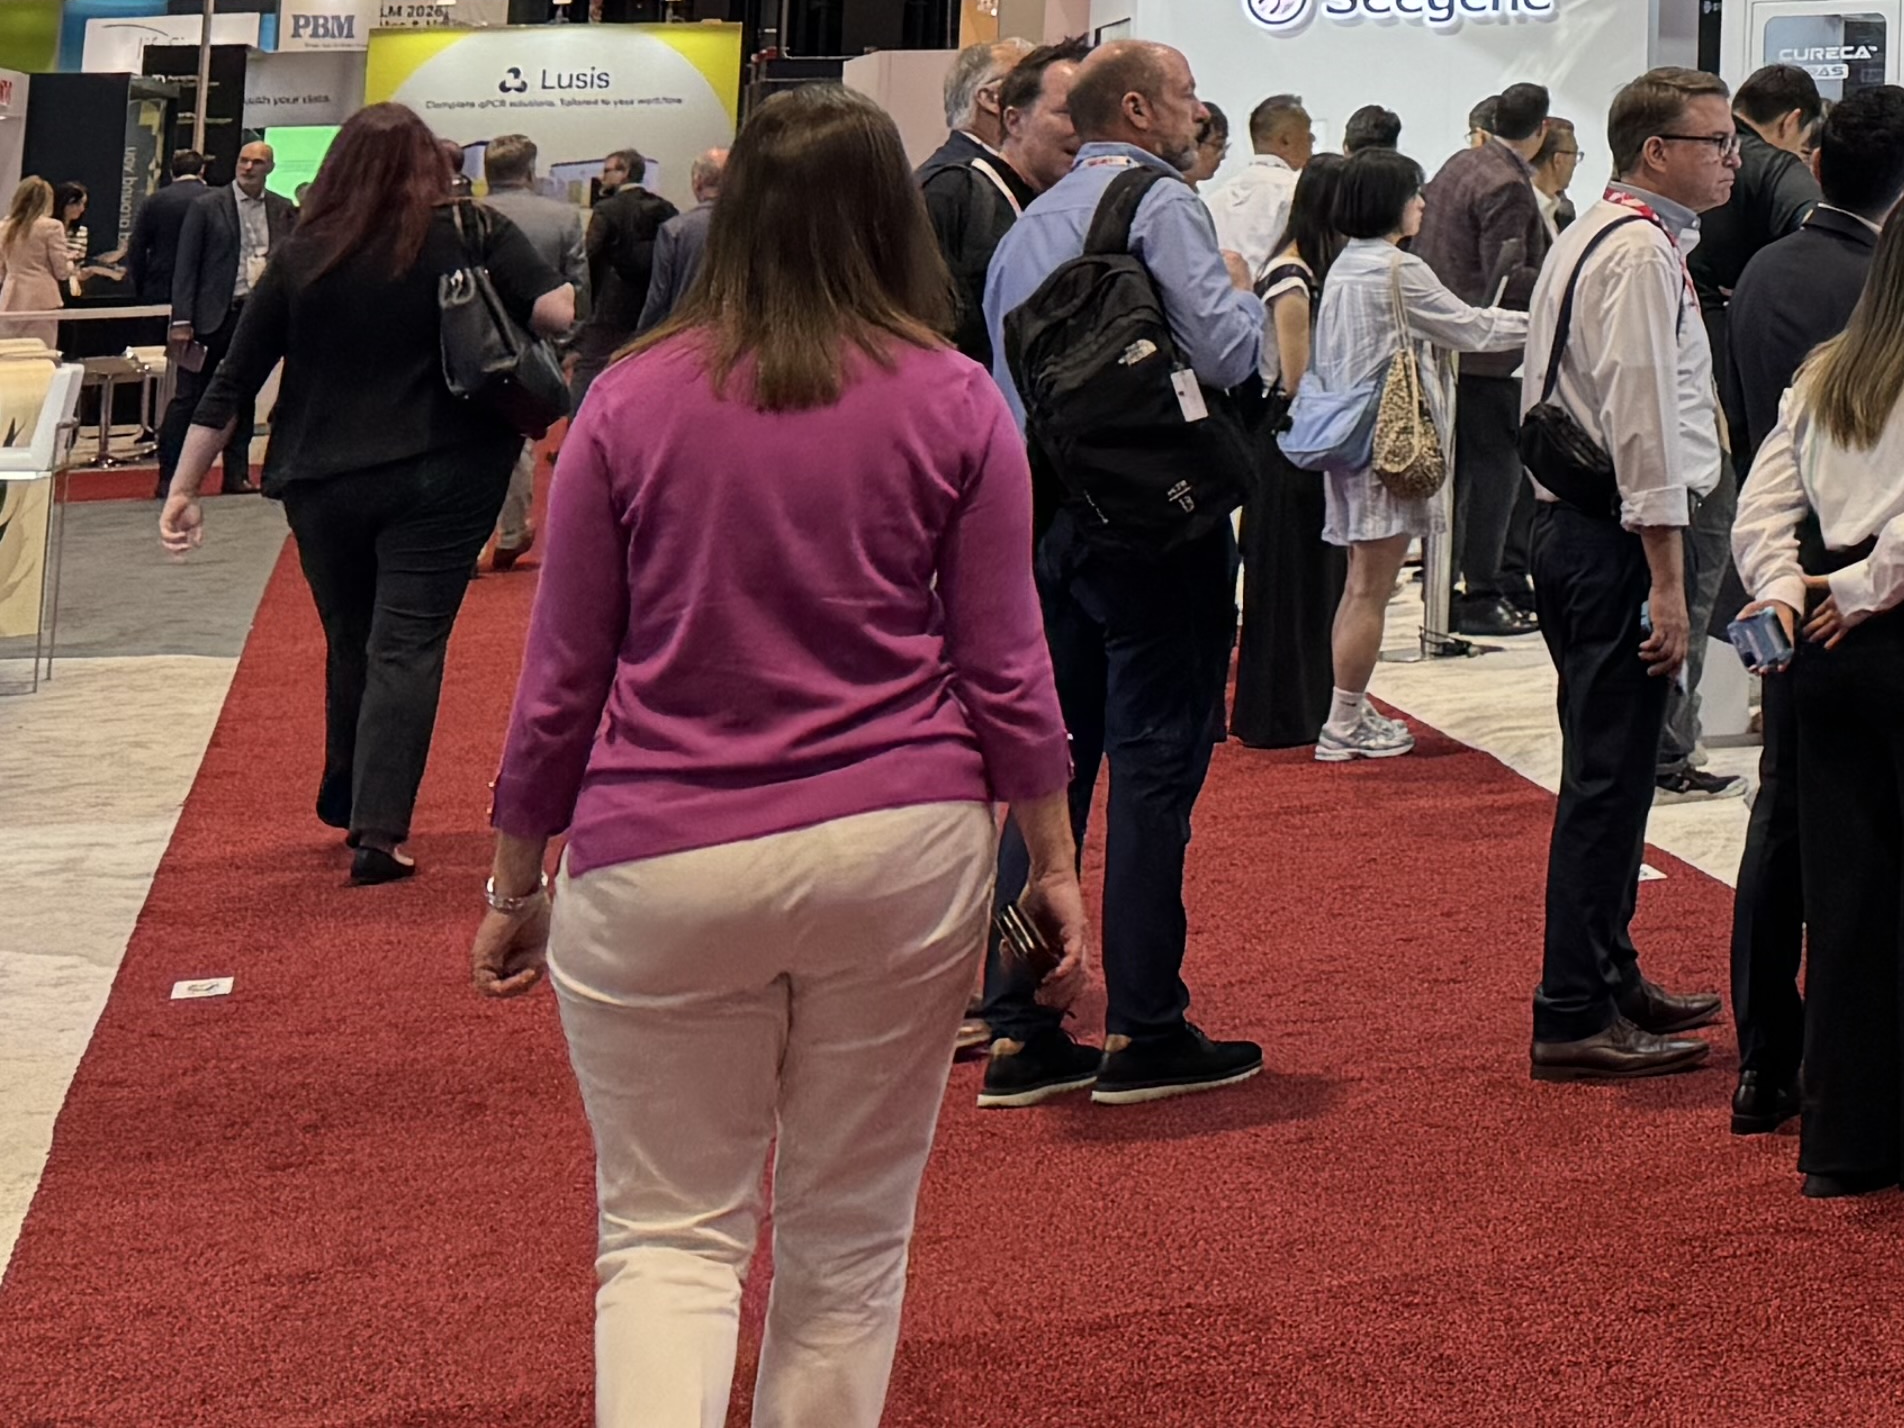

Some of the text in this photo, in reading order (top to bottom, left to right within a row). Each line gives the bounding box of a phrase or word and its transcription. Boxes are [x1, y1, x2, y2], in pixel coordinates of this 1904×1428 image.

[381, 5, 444, 18] LM 2026
[291, 14, 355, 39] PBM
[541, 66, 611, 89] Lusis
